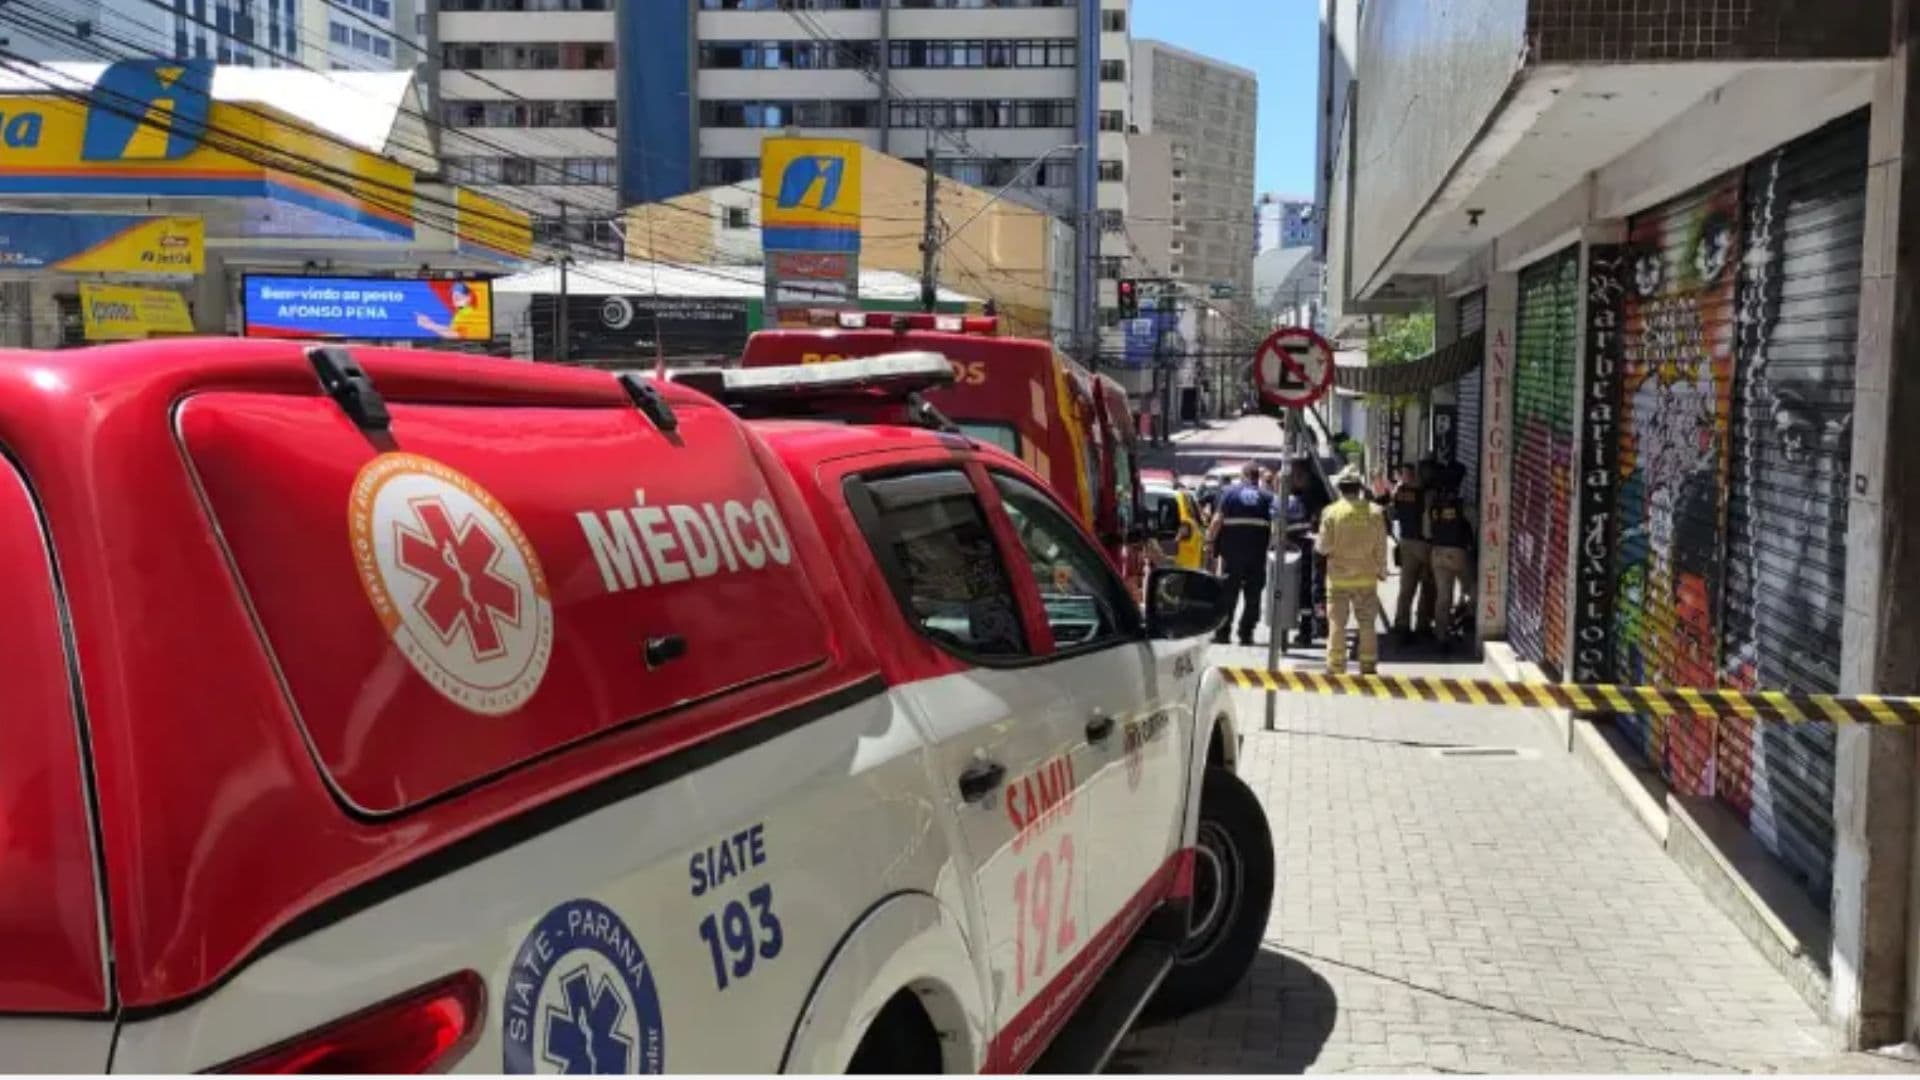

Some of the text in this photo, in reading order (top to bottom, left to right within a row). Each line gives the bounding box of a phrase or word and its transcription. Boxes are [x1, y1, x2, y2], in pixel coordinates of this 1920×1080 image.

[260, 285, 404, 305] Bem-vindo ao posto
[277, 305, 388, 319] AFONSO PENA
[1485, 327, 1506, 618] ANTIGUIDAES
[576, 488, 792, 592] MÉDICO
[1005, 753, 1076, 854] SAMU
[688, 823, 766, 897] SIATE
[699, 883, 784, 992] 193
[1014, 834, 1077, 997] 192
[509, 930, 554, 1042] SIATE
